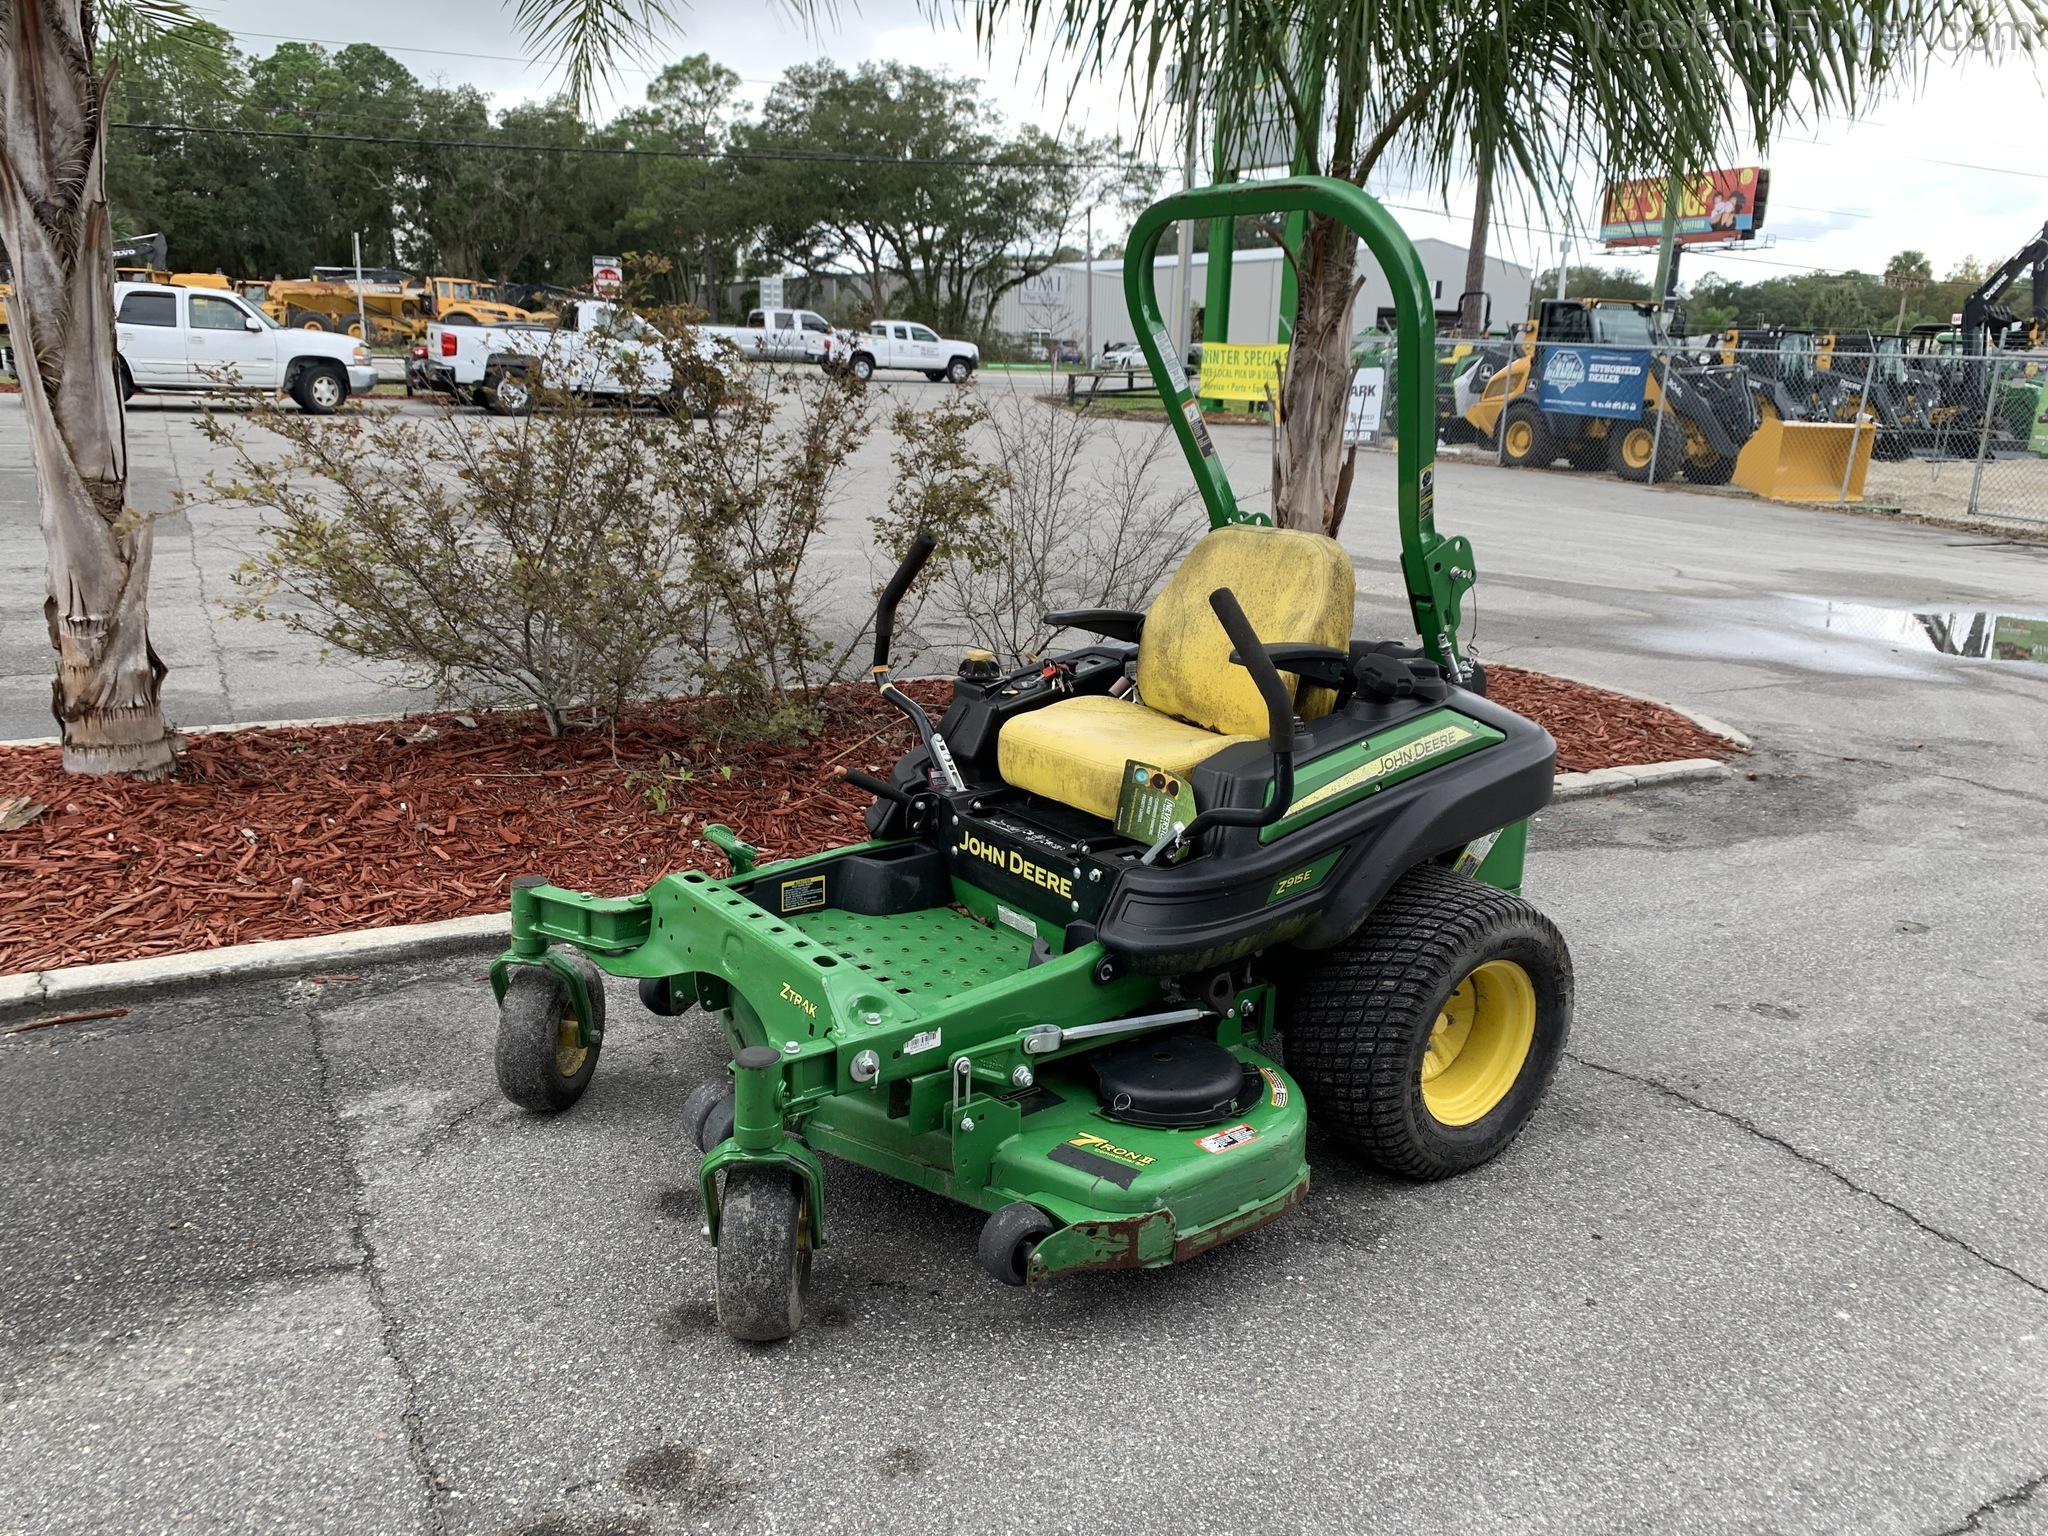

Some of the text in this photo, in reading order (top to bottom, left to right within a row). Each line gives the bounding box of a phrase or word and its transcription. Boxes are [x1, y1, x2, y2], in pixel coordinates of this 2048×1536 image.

[1983, 273, 2010, 300] DEERE
[1202, 348, 1240, 365] WINTER
[1589, 363, 1641, 376] AUTHORIZED
[1588, 373, 1620, 384] DEALER
[1377, 731, 1457, 775] JOHN DEERE
[1160, 801, 1174, 841] NEVERST
[959, 830, 1005, 868] JOHN
[1009, 851, 1073, 899] DEERE
[1275, 869, 1312, 895] Z915E
[779, 981, 818, 1019] ZTRAK
